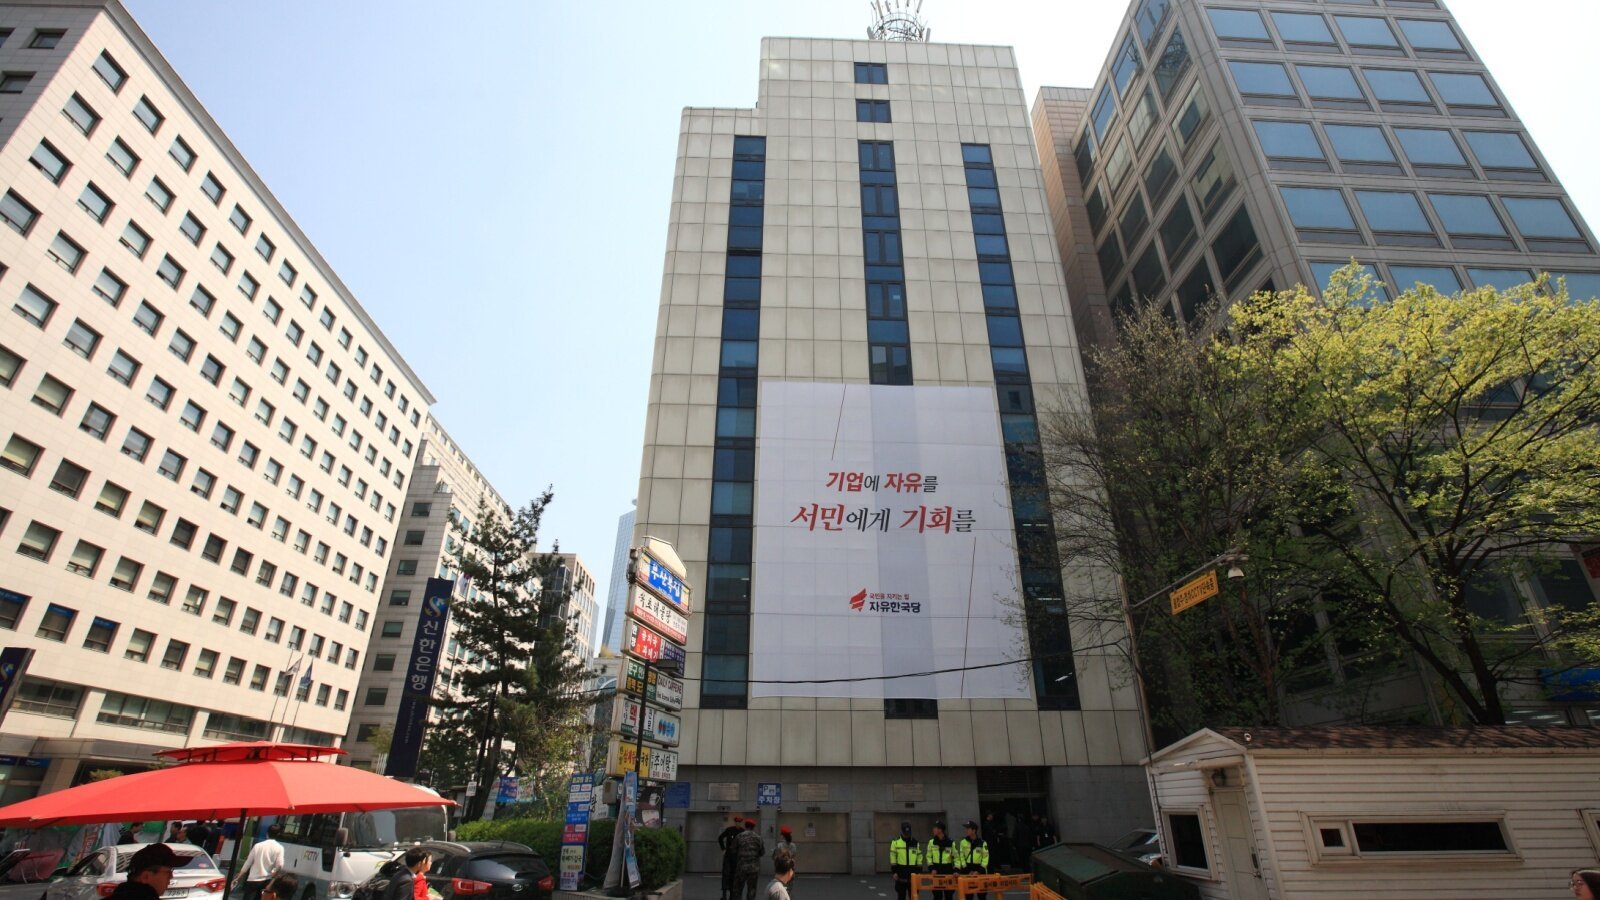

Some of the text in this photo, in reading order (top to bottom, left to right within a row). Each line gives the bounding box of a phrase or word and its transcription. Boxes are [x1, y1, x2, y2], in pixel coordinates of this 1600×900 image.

[826, 471, 939, 493] 기업에 자유를
[790, 503, 976, 535] 서민에게 기회를
[869, 592, 886, 600] 국민을
[869, 601, 921, 614] 자유한국당
[410, 619, 439, 691] 신한은행
[758, 795, 780, 804] 주차장
